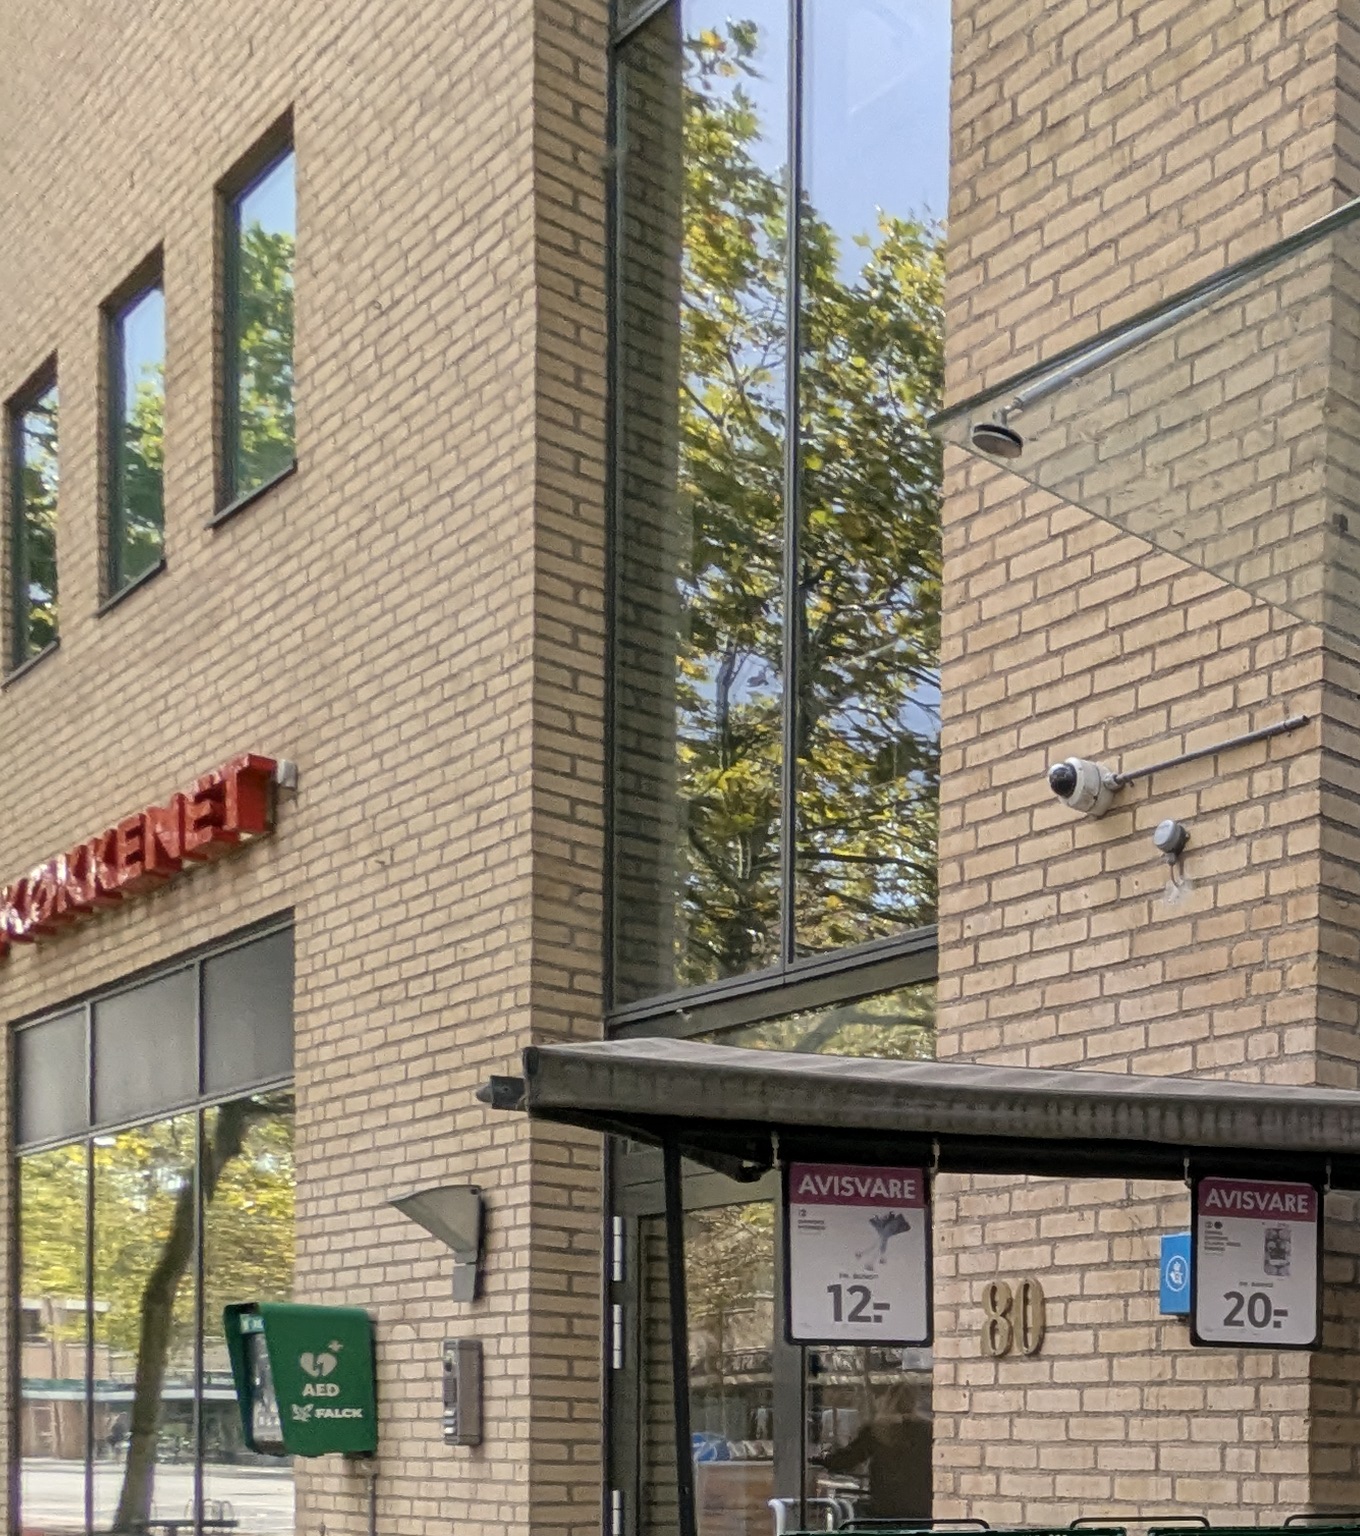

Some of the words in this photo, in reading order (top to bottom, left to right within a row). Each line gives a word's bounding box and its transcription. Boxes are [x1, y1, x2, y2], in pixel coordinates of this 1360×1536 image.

[799, 1174, 916, 1199] AVISVARE
[1205, 1188, 1308, 1213] AVISVARE
[980, 1278, 1046, 1358] 80
[302, 1383, 340, 1397] AED
[314, 1408, 363, 1419] FALCK
